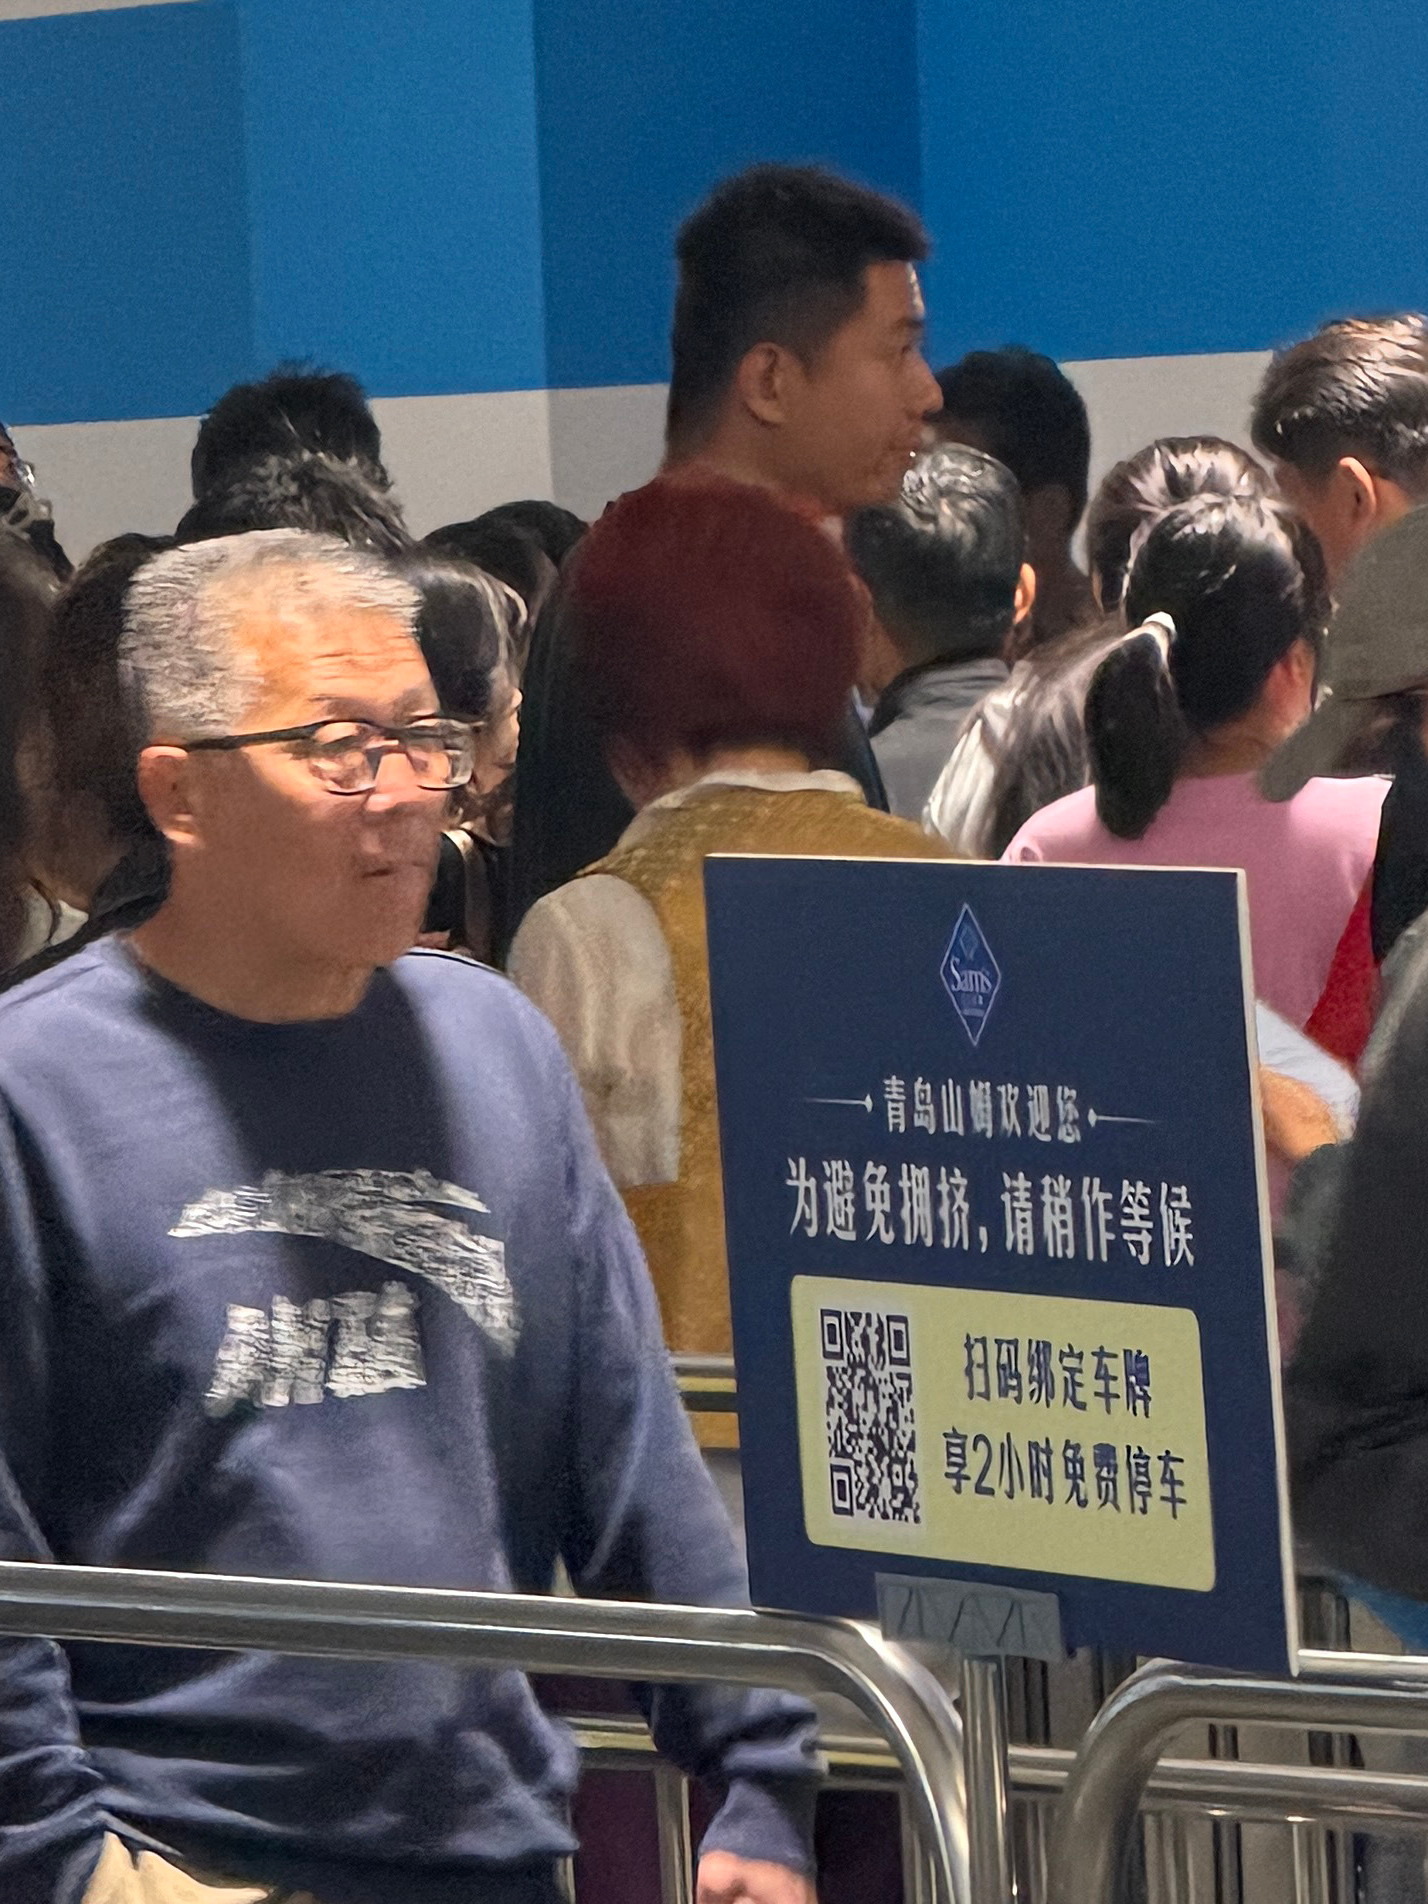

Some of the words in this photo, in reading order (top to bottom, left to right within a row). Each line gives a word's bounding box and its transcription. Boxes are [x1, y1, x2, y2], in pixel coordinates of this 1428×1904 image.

[883, 1075, 1082, 1143] 青岛山姆欢迎您
[964, 1332, 1152, 1419] 扫码绑定车牌
[942, 1425, 1188, 1521] 享2小时免费停车
